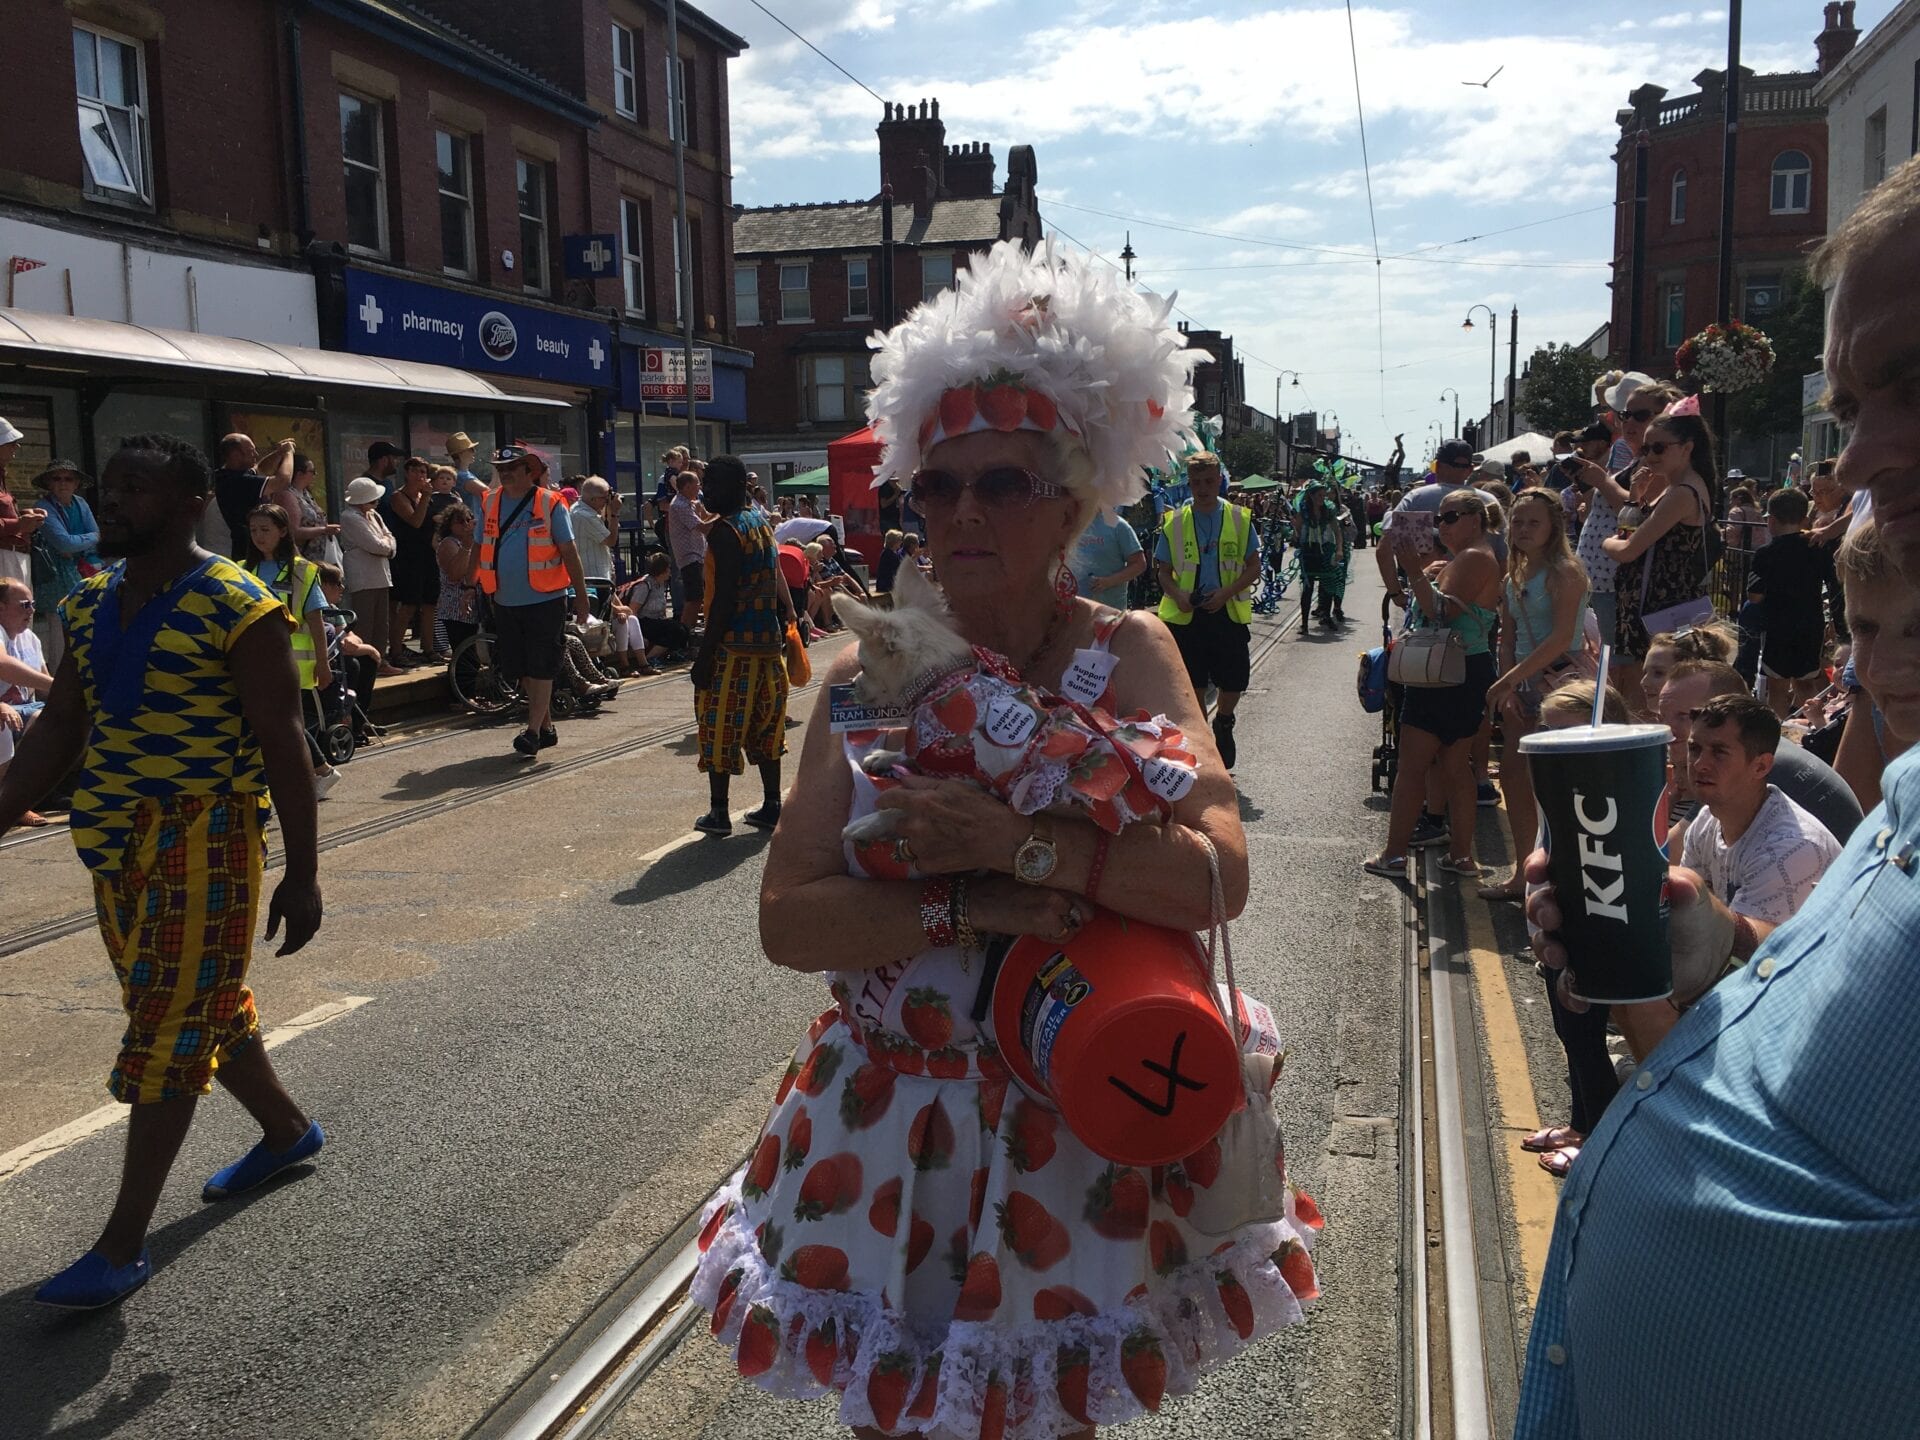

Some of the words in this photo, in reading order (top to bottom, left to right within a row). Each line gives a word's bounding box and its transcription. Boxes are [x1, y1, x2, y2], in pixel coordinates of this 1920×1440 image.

[15, 258, 42, 272] FO
[402, 310, 464, 340] pharmacy
[488, 323, 515, 346] Boots
[536, 335, 570, 358] beauty
[643, 385, 664, 394] 0161
[666, 385, 683, 394] 631
[1073, 665, 1106, 682] Support
[1076, 674, 1097, 689] Tram
[1067, 680, 1099, 698] Sunday
[832, 710, 864, 721] TRAM
[991, 703, 1018, 732] Support
[1002, 711, 1022, 730] Tram
[1008, 713, 1034, 740] Sunday
[1150, 764, 1169, 785] Supp
[1573, 793, 1629, 924] KFC
